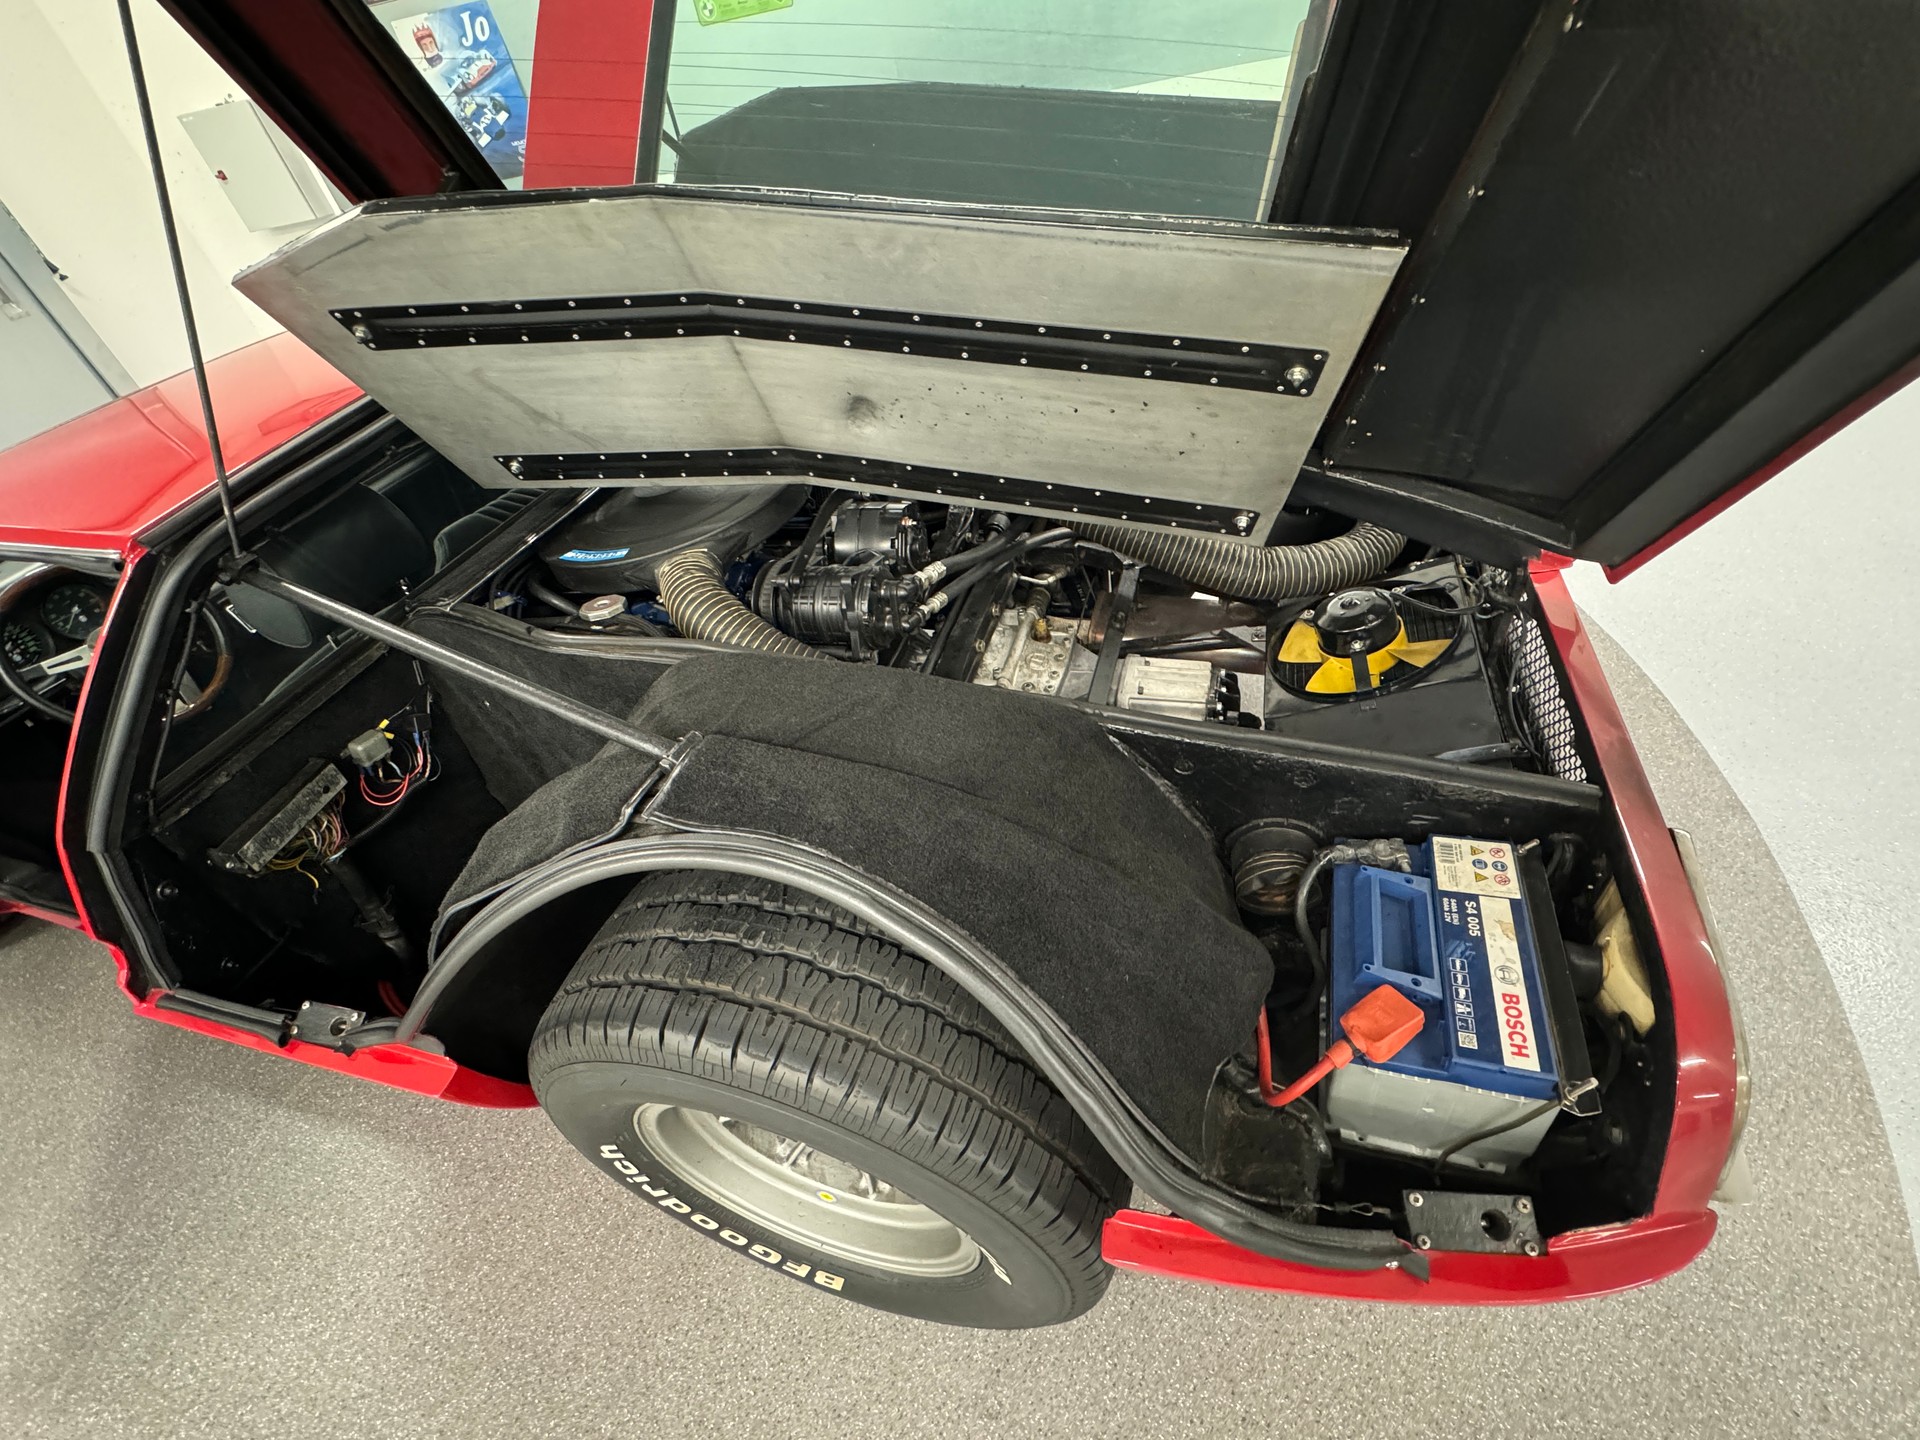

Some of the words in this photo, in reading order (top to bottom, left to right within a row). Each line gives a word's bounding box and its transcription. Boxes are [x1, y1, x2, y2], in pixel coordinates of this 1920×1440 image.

[460, 11, 490, 47] Jo
[1464, 900, 1478, 914] S4
[1467, 917, 1481, 937] 005
[1501, 993, 1530, 1059] BOSCH
[600, 1144, 845, 1291] BFGoodrich
